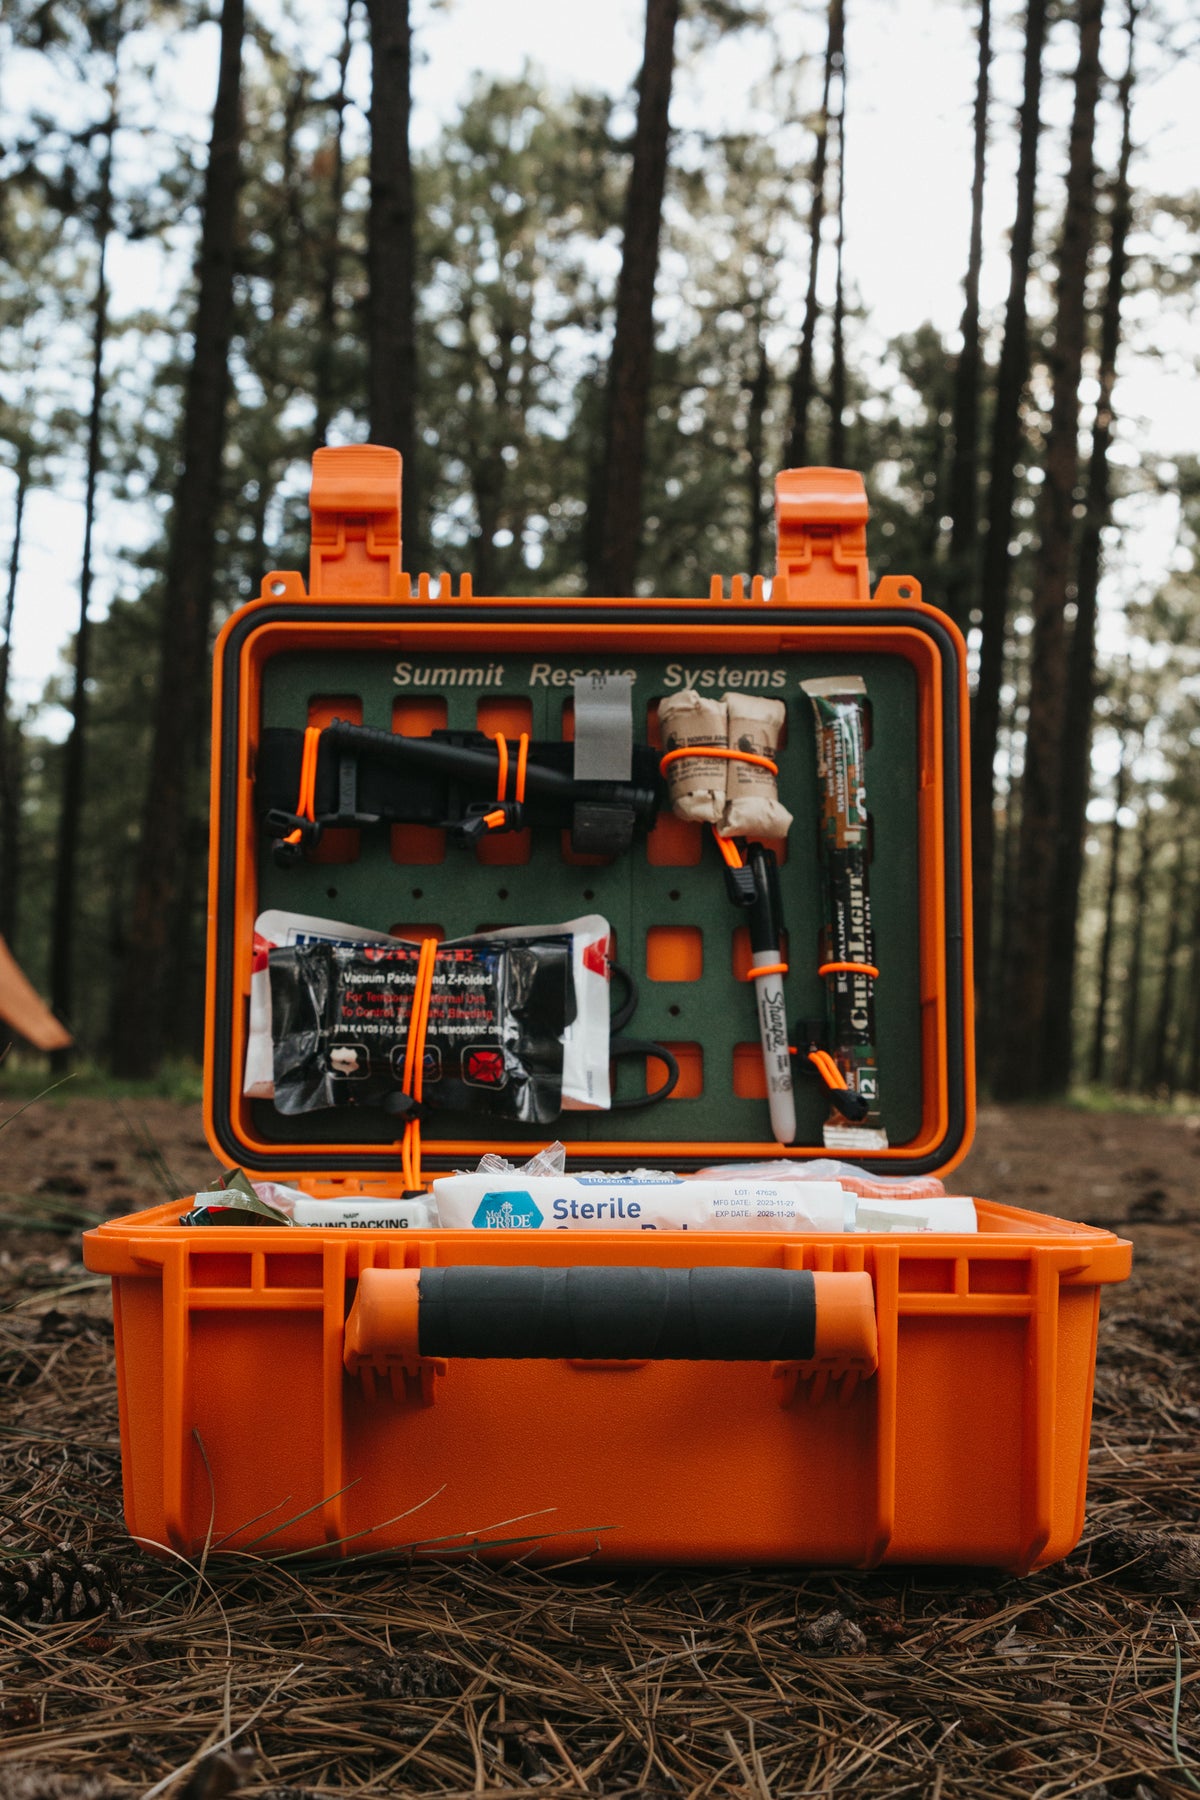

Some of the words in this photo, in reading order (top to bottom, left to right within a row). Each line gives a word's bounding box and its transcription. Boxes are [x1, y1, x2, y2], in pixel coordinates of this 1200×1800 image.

[393, 662, 504, 687] Summit
[663, 663, 787, 691] Systems
[344, 972, 386, 984] Vacuum
[387, 972, 418, 985] Packe
[447, 974, 492, 986] Z-Folded
[553, 1198, 641, 1220] Sterile
[350, 1218, 409, 1228] PACKING
